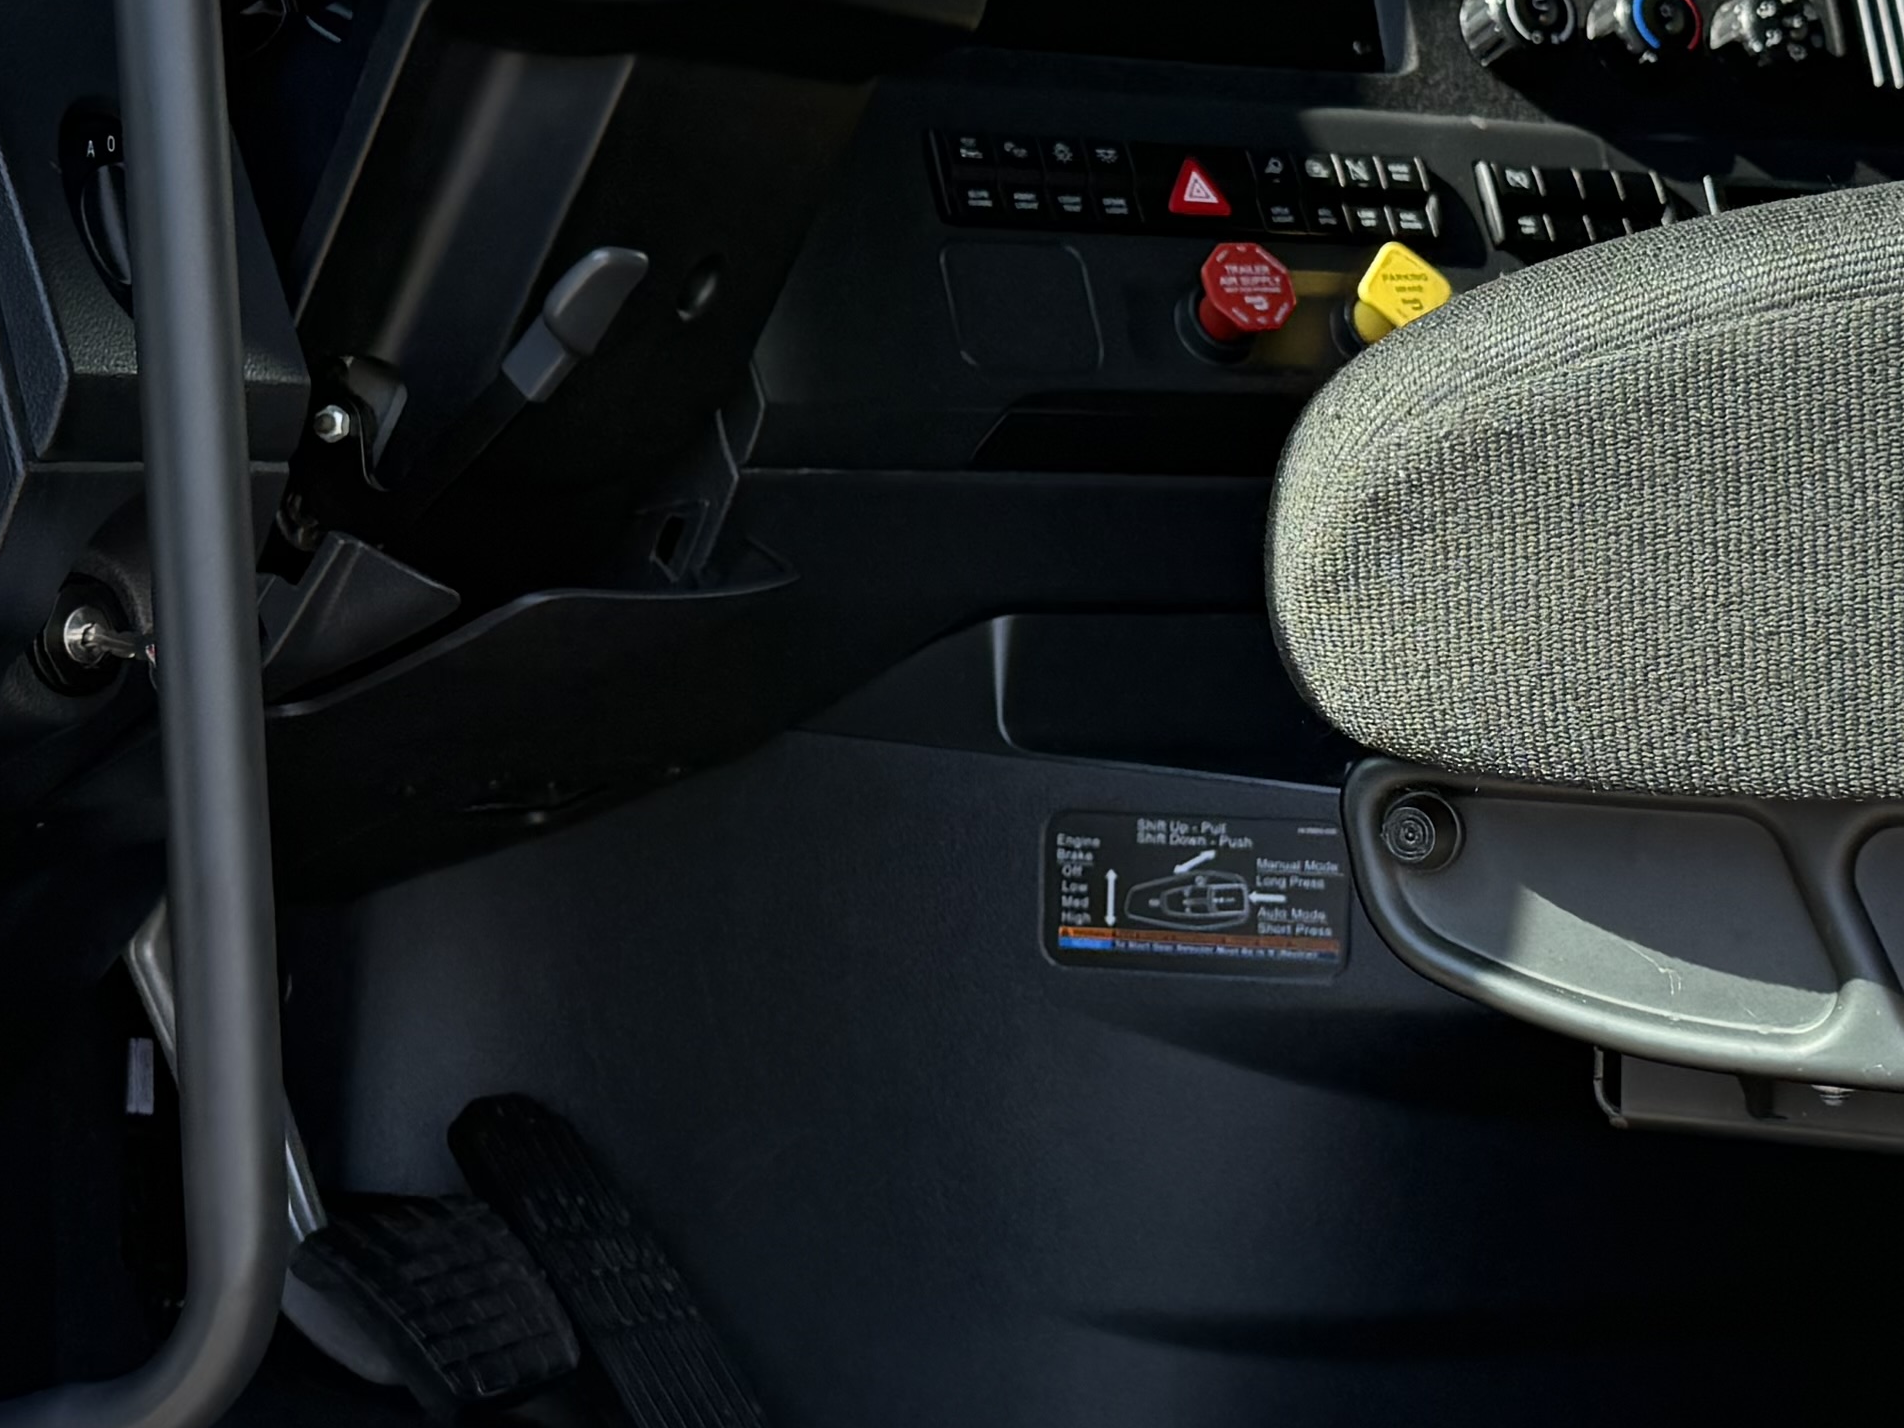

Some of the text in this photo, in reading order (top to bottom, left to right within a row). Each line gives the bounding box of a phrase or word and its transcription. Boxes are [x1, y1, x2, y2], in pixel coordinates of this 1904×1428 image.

[86, 139, 96, 158] A
[1224, 264, 1271, 275] TRAILER
[1219, 276, 1281, 286] AIR SUPPLY
[1136, 818, 1167, 832] Shift
[1169, 819, 1189, 834] Up
[1201, 820, 1227, 835] Pull
[1057, 832, 1101, 849] Engine
[1136, 832, 1167, 845] Shift
[1169, 833, 1207, 846] Down
[1219, 835, 1253, 849] Push
[1057, 847, 1094, 862] Brake
[1061, 863, 1083, 877] Off
[1256, 857, 1338, 872] Manual Mode
[1061, 879, 1089, 893] Low
[1256, 875, 1326, 890] Long Press
[1061, 894, 1090, 909] Med
[1061, 910, 1092, 926] High
[1257, 906, 1327, 921] Auto Mode
[1258, 922, 1333, 937] Short Press
